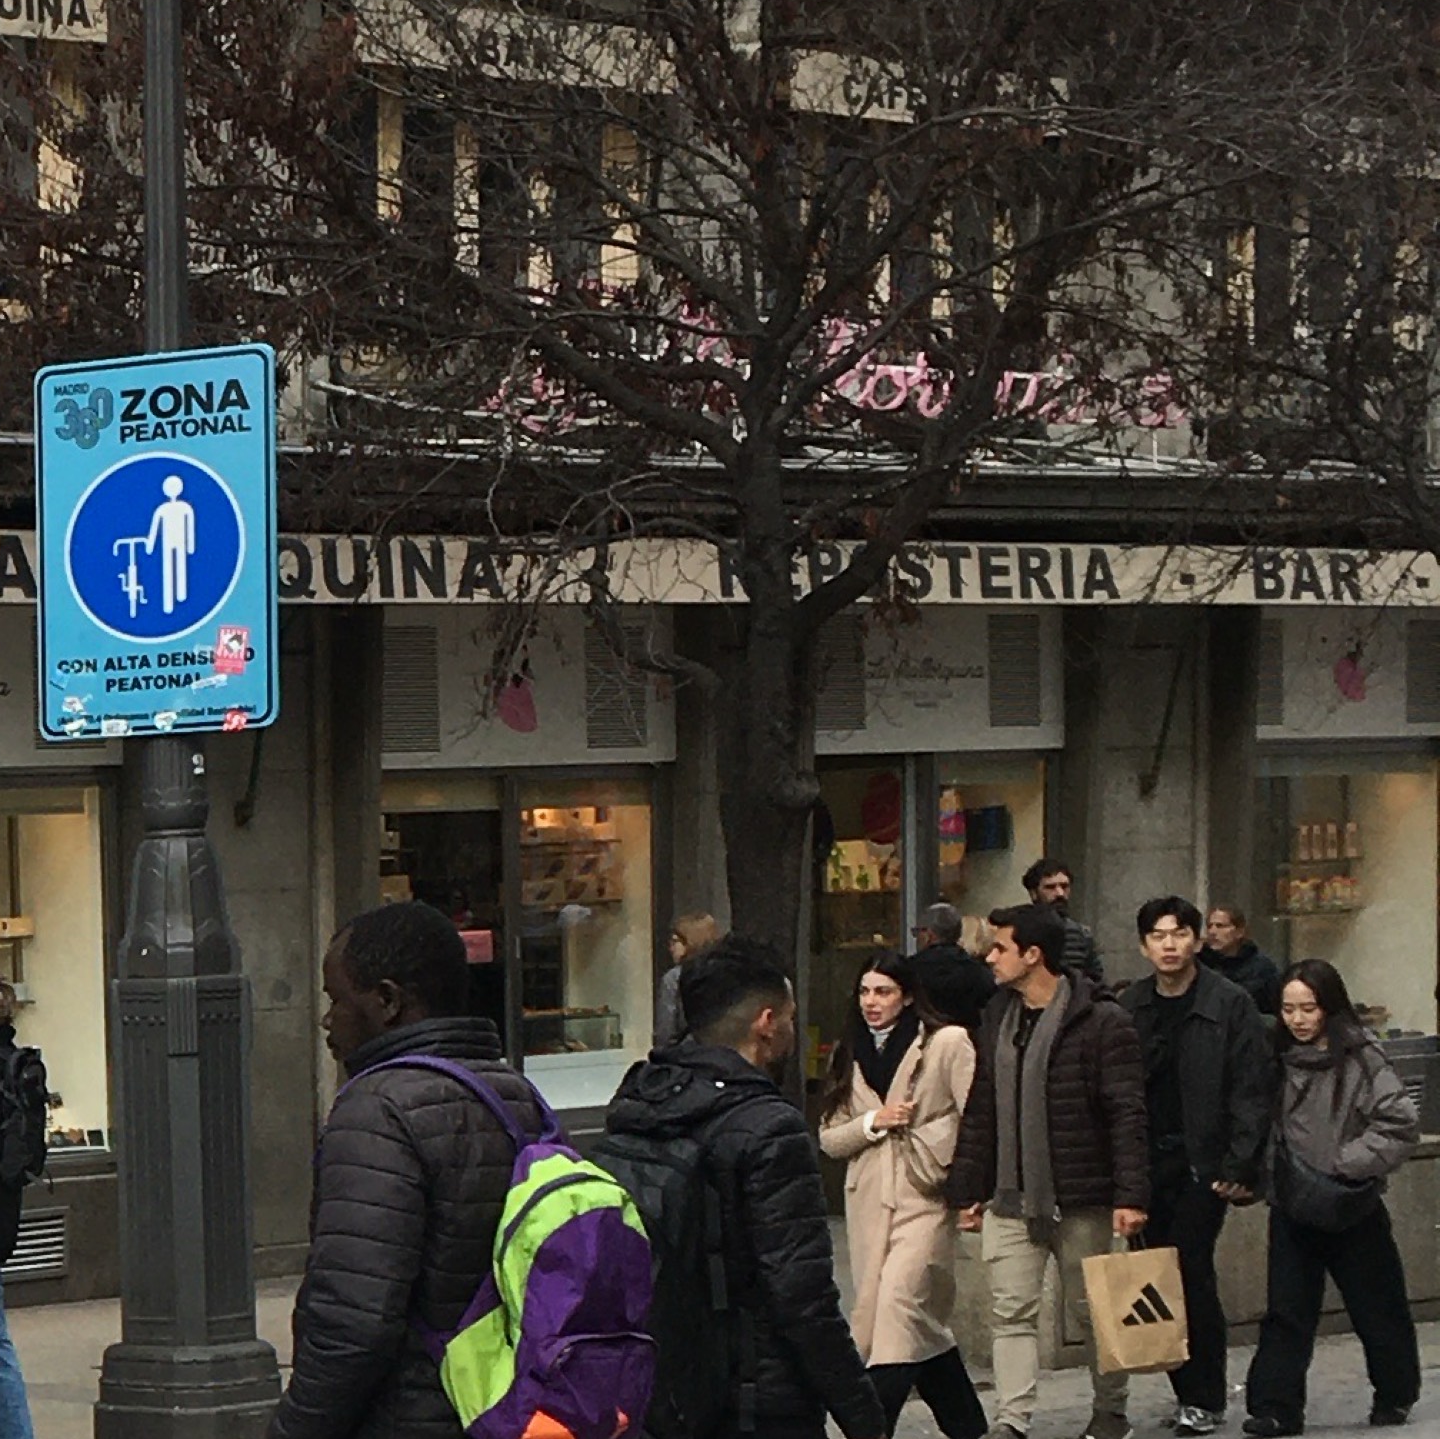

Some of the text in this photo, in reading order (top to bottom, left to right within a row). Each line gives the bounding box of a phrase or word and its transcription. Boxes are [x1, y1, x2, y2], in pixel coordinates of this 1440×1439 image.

[54, 383, 89, 397] MADRID
[120, 379, 250, 421] ZONA
[120, 415, 252, 444] PEATONAL
[1253, 547, 1361, 600] BAR
[57, 658, 99, 674] CON
[104, 653, 151, 671] ALTA
